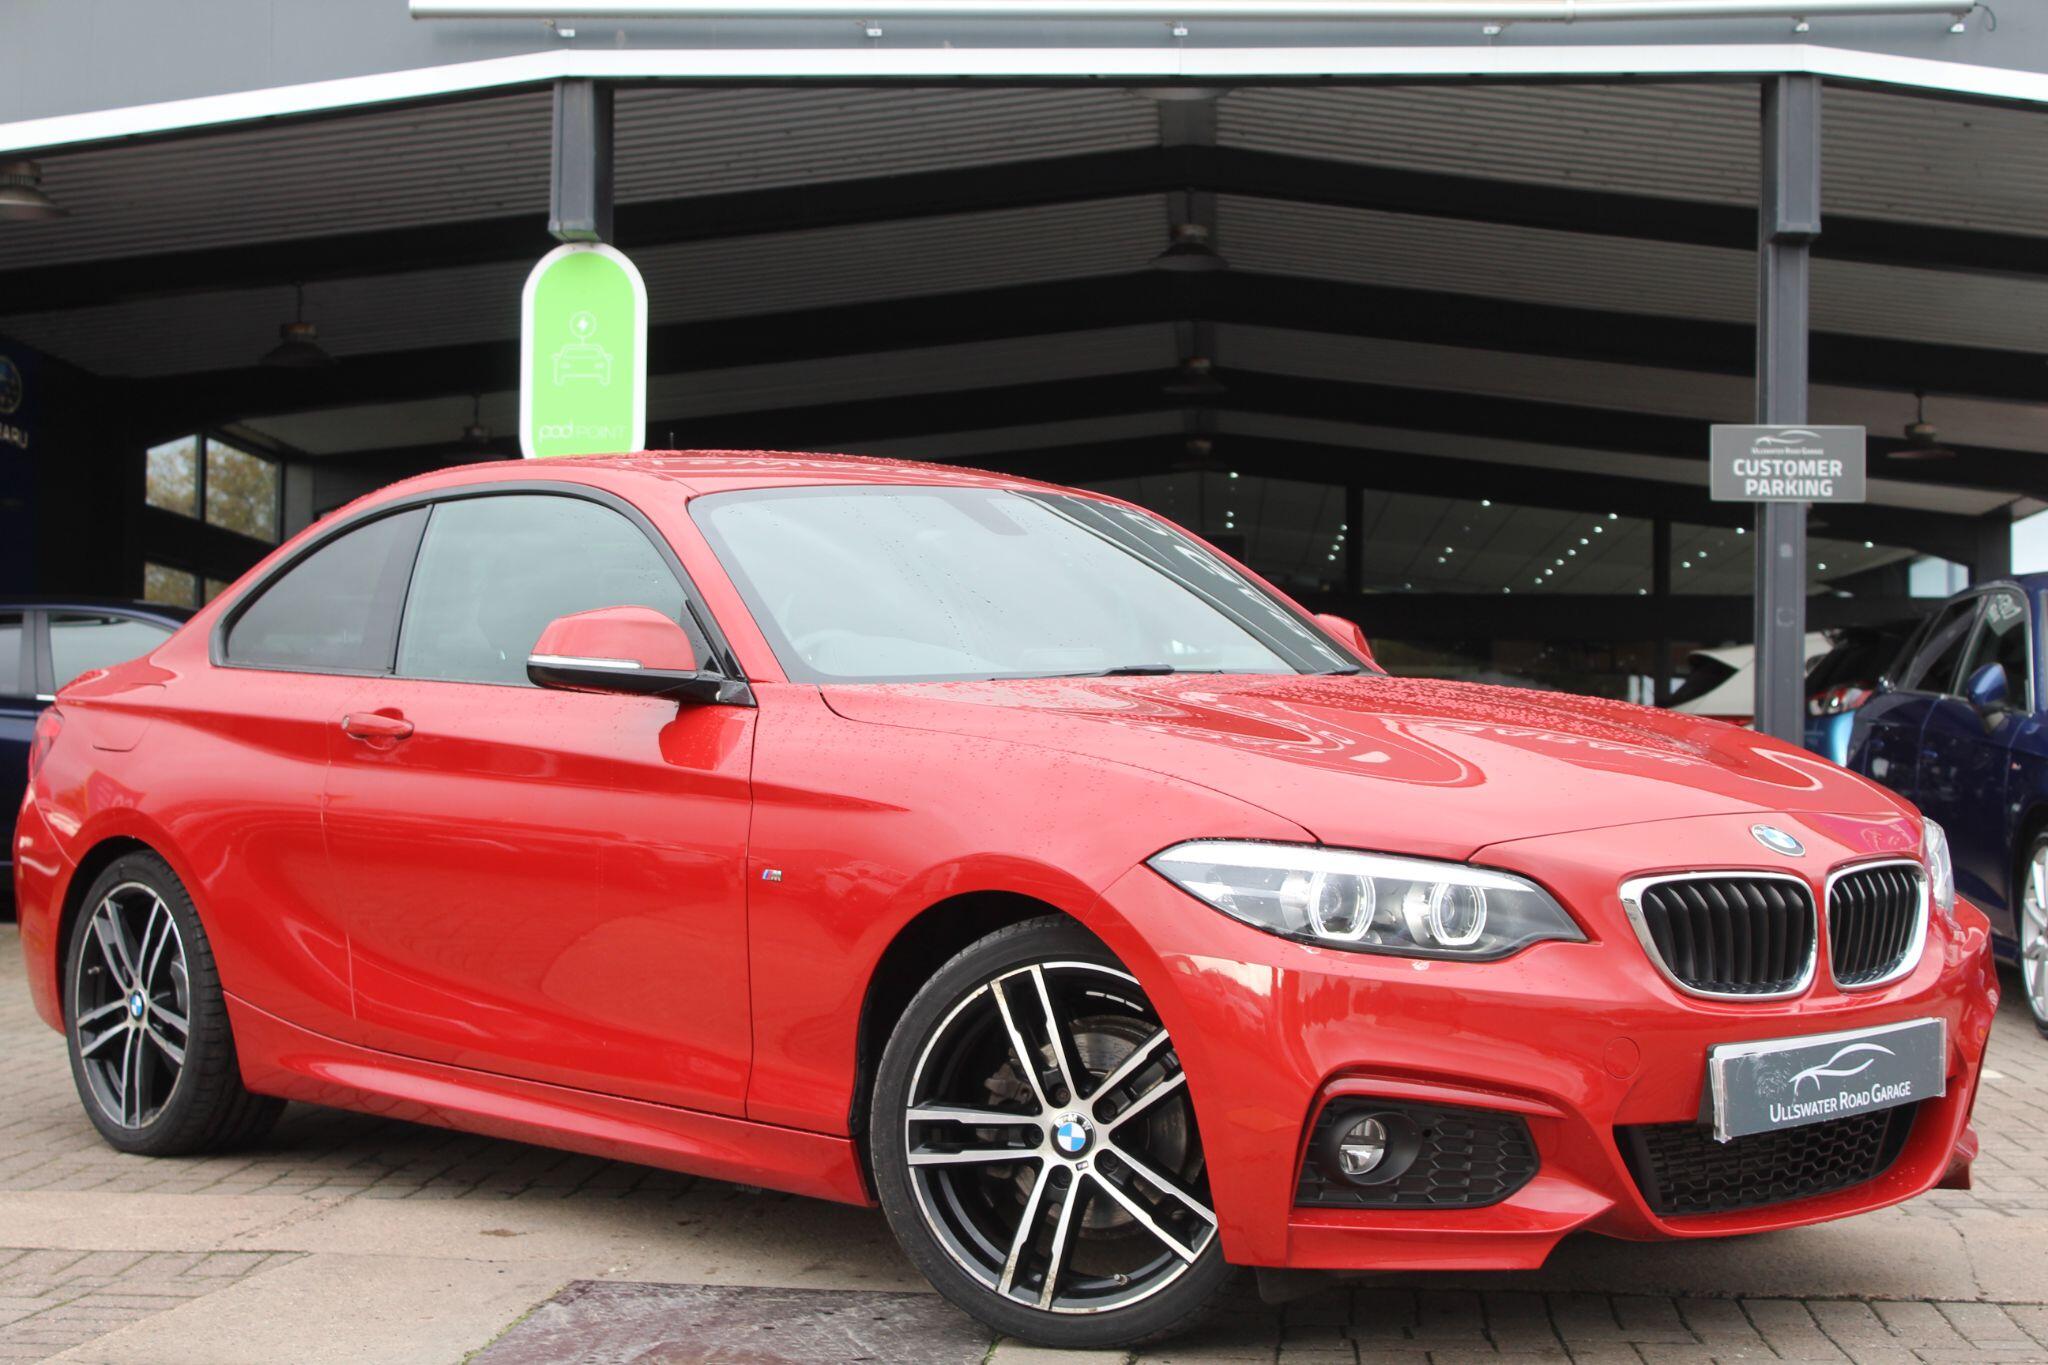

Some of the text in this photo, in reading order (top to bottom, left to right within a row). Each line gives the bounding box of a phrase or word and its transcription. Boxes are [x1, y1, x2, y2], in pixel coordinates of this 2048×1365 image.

[0, 423, 28, 448] ARU
[1733, 458, 1843, 477] CUSTOMER
[1745, 478, 1833, 497] PARKING
